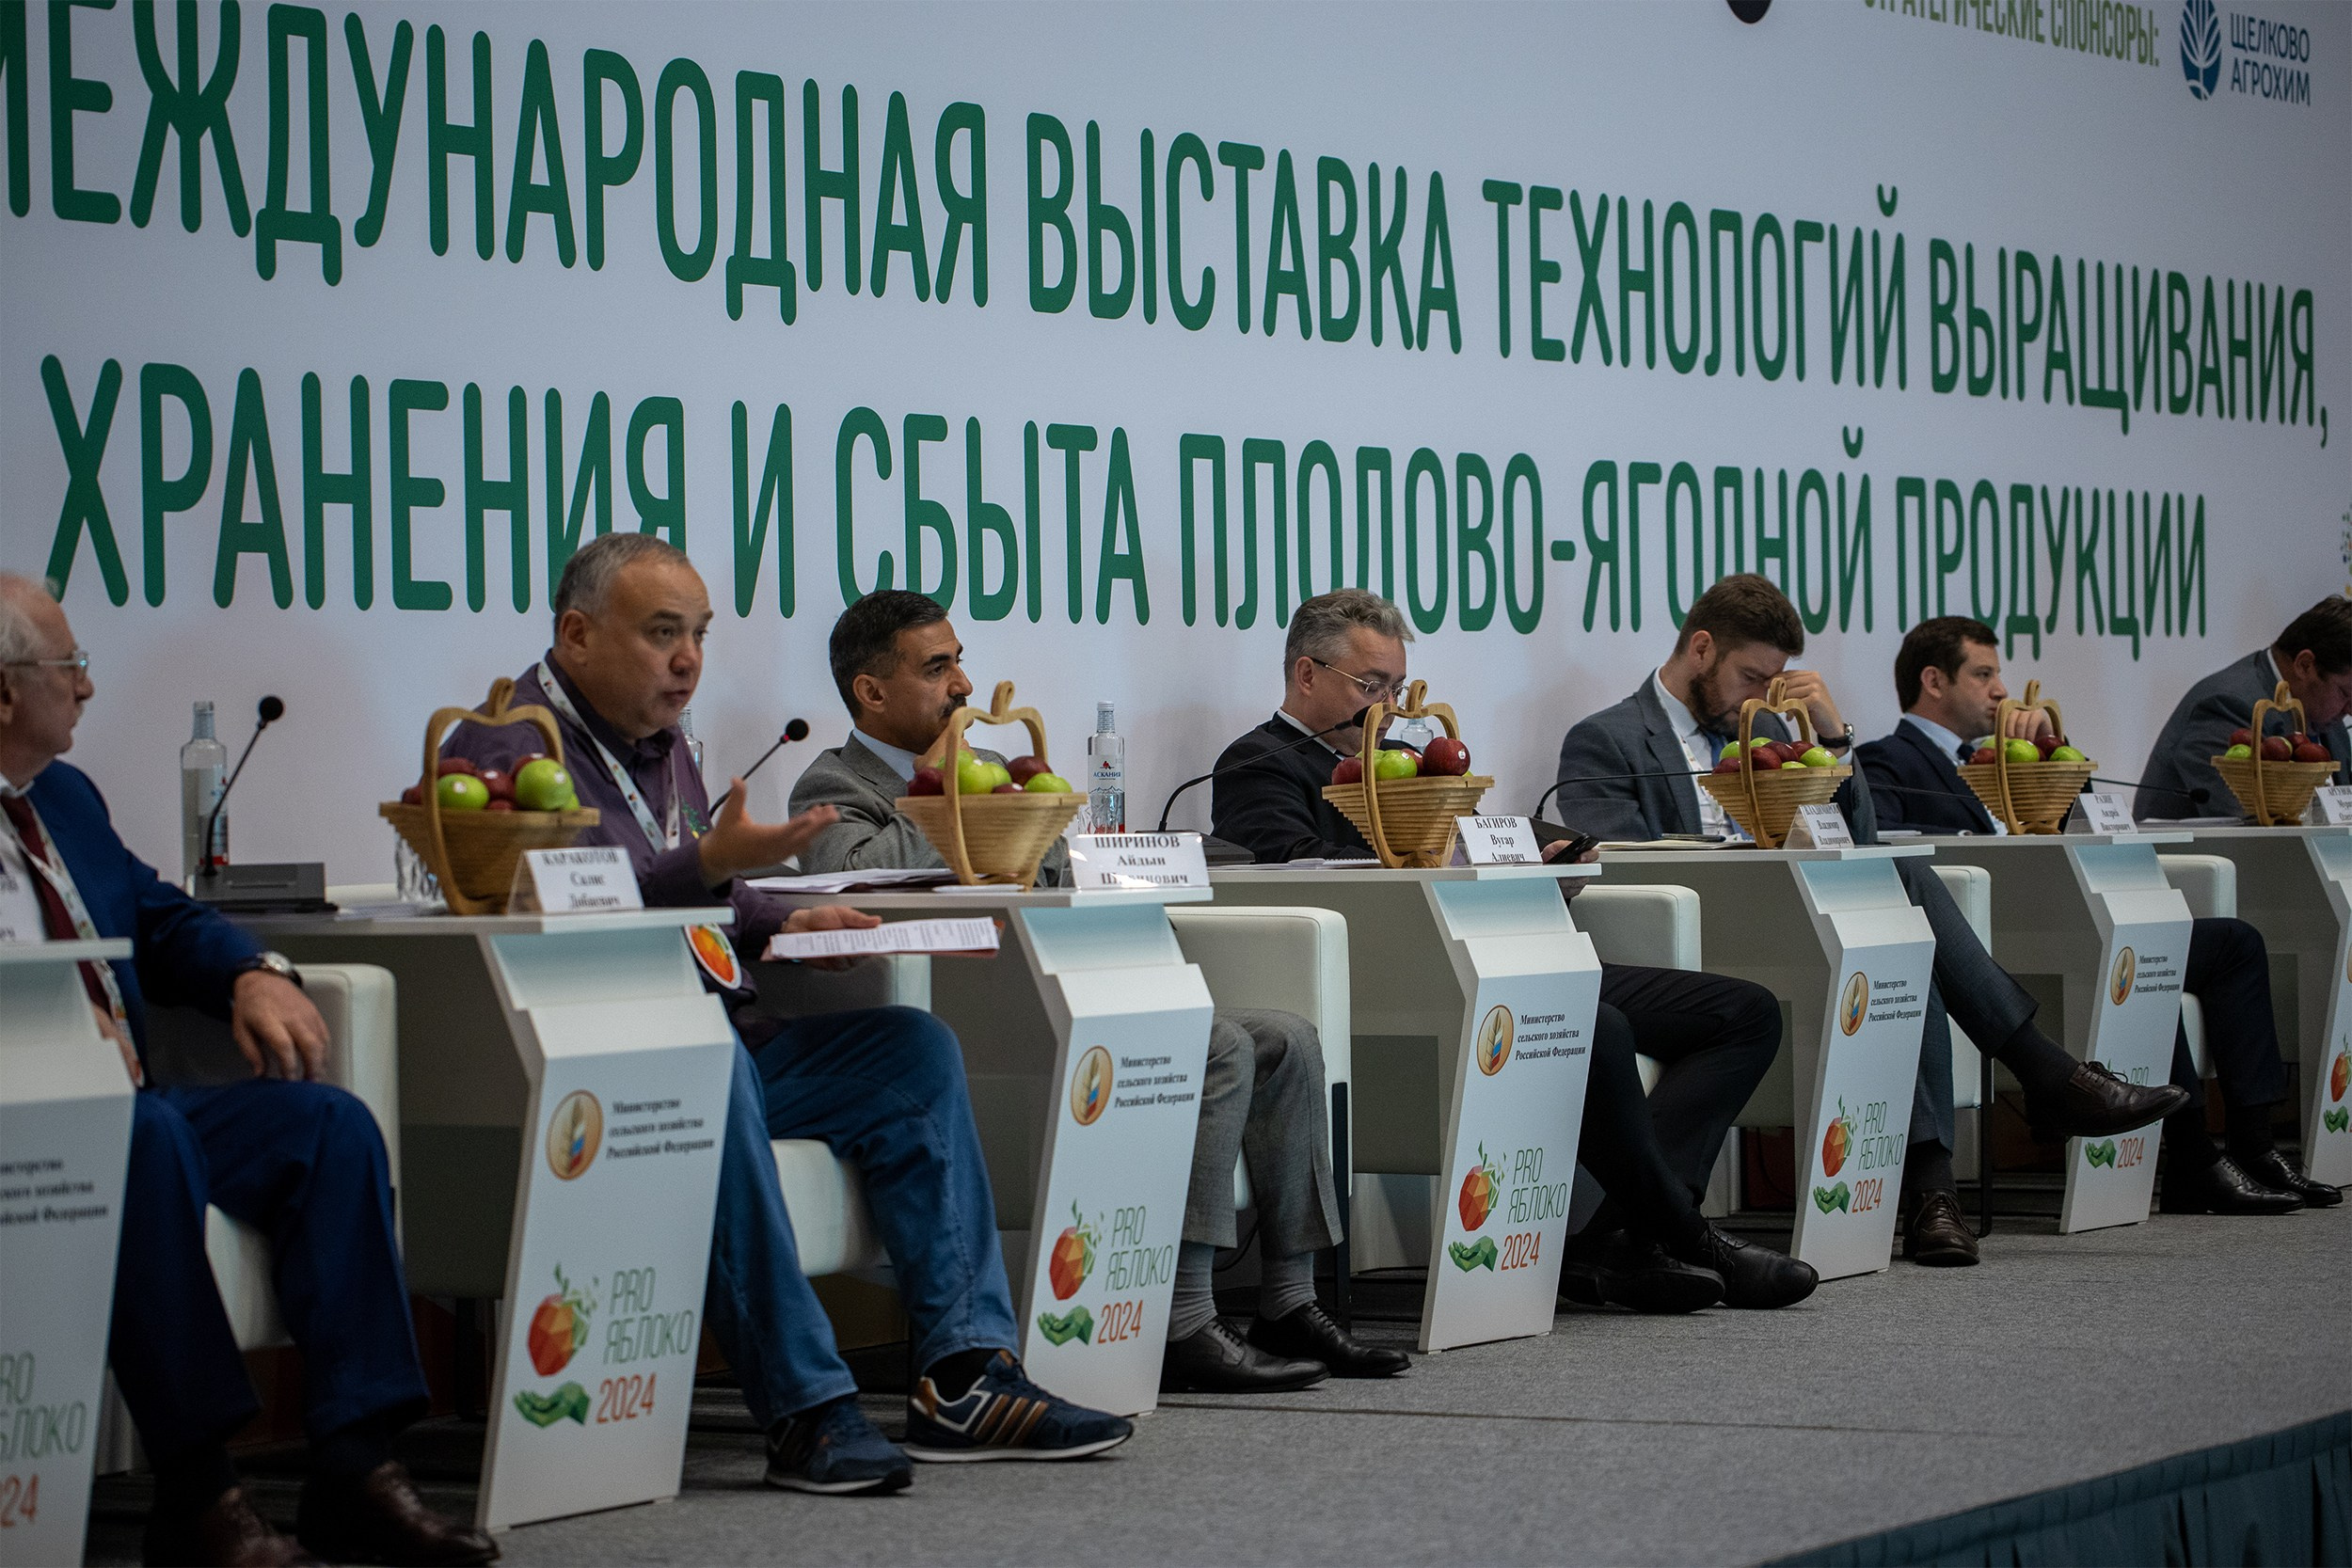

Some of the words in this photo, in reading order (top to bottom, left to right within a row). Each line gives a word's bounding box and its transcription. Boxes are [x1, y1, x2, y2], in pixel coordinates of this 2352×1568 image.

[2231, 12, 2311, 63] ЩЕЛКОВО
[2231, 57, 2312, 106] АГРОХИМ
[1026, 112, 1462, 355] ВЫСТАВКА
[1483, 180, 1907, 391] ТЕХНОЛОГИЙ
[1929, 238, 2328, 449] ВЫРАЩИВАНИЯ,
[40, 354, 687, 614] ХРАНЕНИЯ
[731, 400, 795, 619] И
[835, 407, 1150, 626] СБЫТА
[1896, 476, 2206, 661] ПРОДУКЦИИ
[1094, 835, 1181, 848] ШИРИНОВ
[1474, 816, 1518, 829] БАГИРОВ
[1490, 834, 1515, 847] Вугар
[1117, 854, 1167, 866] Айдын
[1491, 852, 1525, 863] Алиевич
[1517, 1032, 1549, 1043] сельского
[1549, 1028, 1580, 1040] хозяйства
[1519, 1013, 1565, 1025] Министерство
[1515, 1047, 1551, 1060] Российской
[1551, 1046, 1586, 1059] Федерации
[1864, 1101, 1887, 1135] PRO
[1513, 1147, 1544, 1185] PRO
[1858, 1132, 1904, 1171] ЯБЛОКО
[2117, 1136, 2145, 1168] 2024
[1507, 1182, 1567, 1224] ЯБЛОКО
[1851, 1177, 1883, 1213] 2024
[1111, 1206, 1147, 1247] PRO
[1104, 1244, 1174, 1292] ЯБЛОКО
[1501, 1230, 1541, 1271] 2024
[610, 1266, 657, 1316] PRO
[603, 1308, 695, 1365] ЯБЛОКО
[1097, 1299, 1144, 1344] 2024
[596, 1371, 657, 1424] 2024
